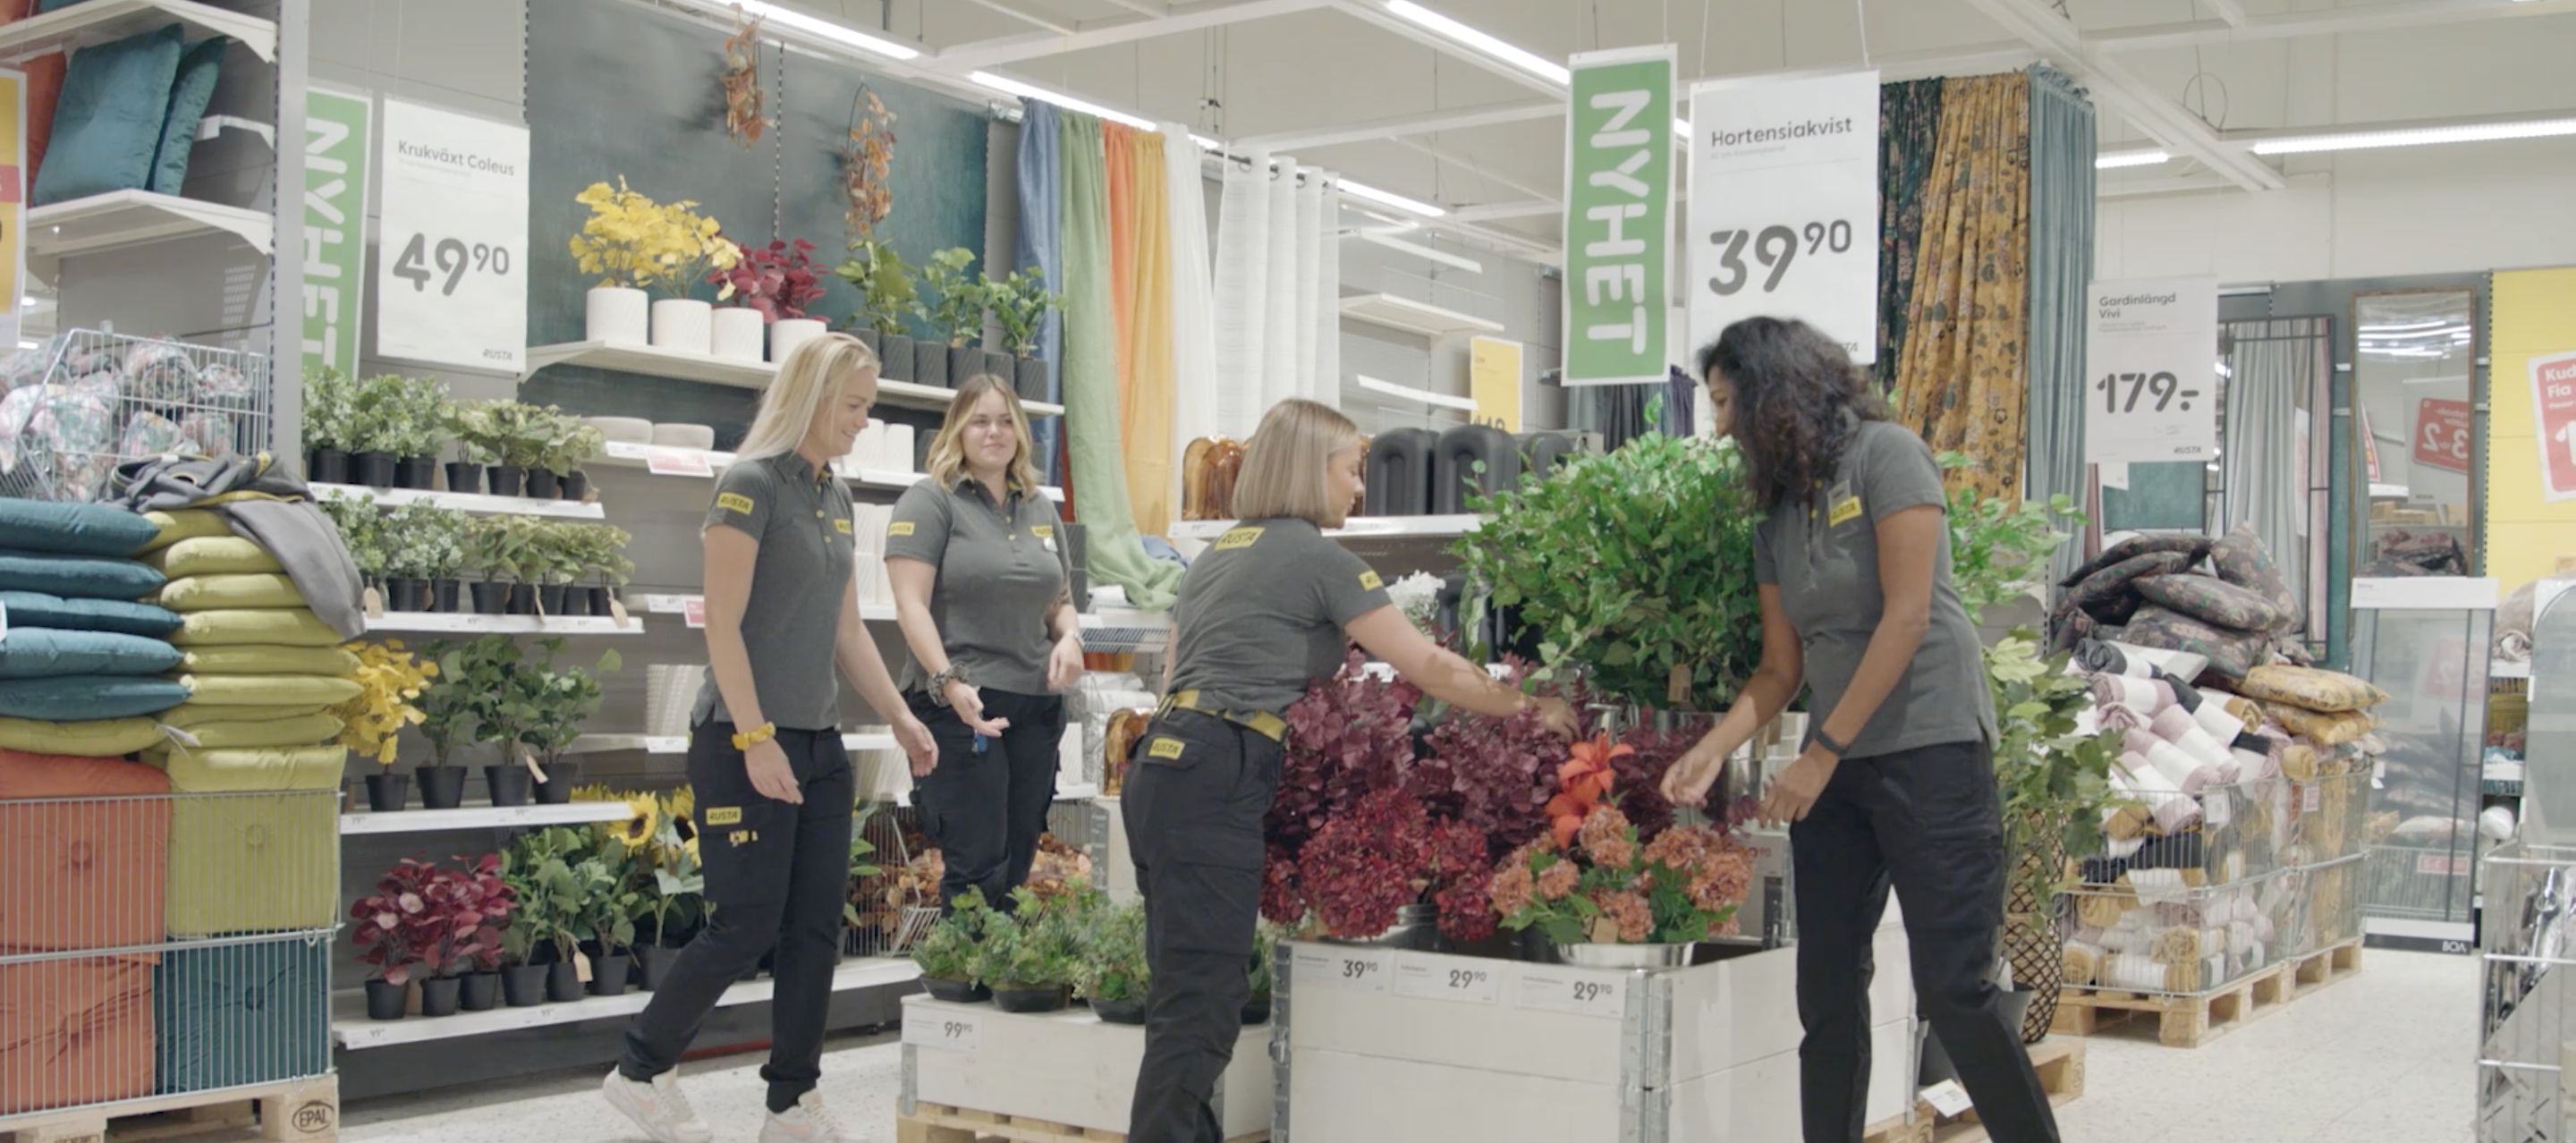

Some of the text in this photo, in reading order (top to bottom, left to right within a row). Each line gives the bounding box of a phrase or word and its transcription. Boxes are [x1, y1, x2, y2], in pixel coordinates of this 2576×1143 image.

[1711, 116, 1852, 148] Hortensiakvist
[398, 140, 464, 166] Krukväxt
[467, 155, 515, 176] Coleus
[1586, 89, 1651, 355] NYHET
[302, 117, 350, 368] NYHET
[2098, 292, 2176, 307] Gardinlängd
[2098, 308, 2121, 318] Vivi
[482, 348, 513, 361] RUSTA
[2547, 383, 2572, 398] Fia
[2174, 446, 2202, 454] RUSTA
[1221, 529, 1258, 545] RUSTA
[710, 810, 739, 821] RUSTA
[300, 1108, 332, 1128] EPAL
